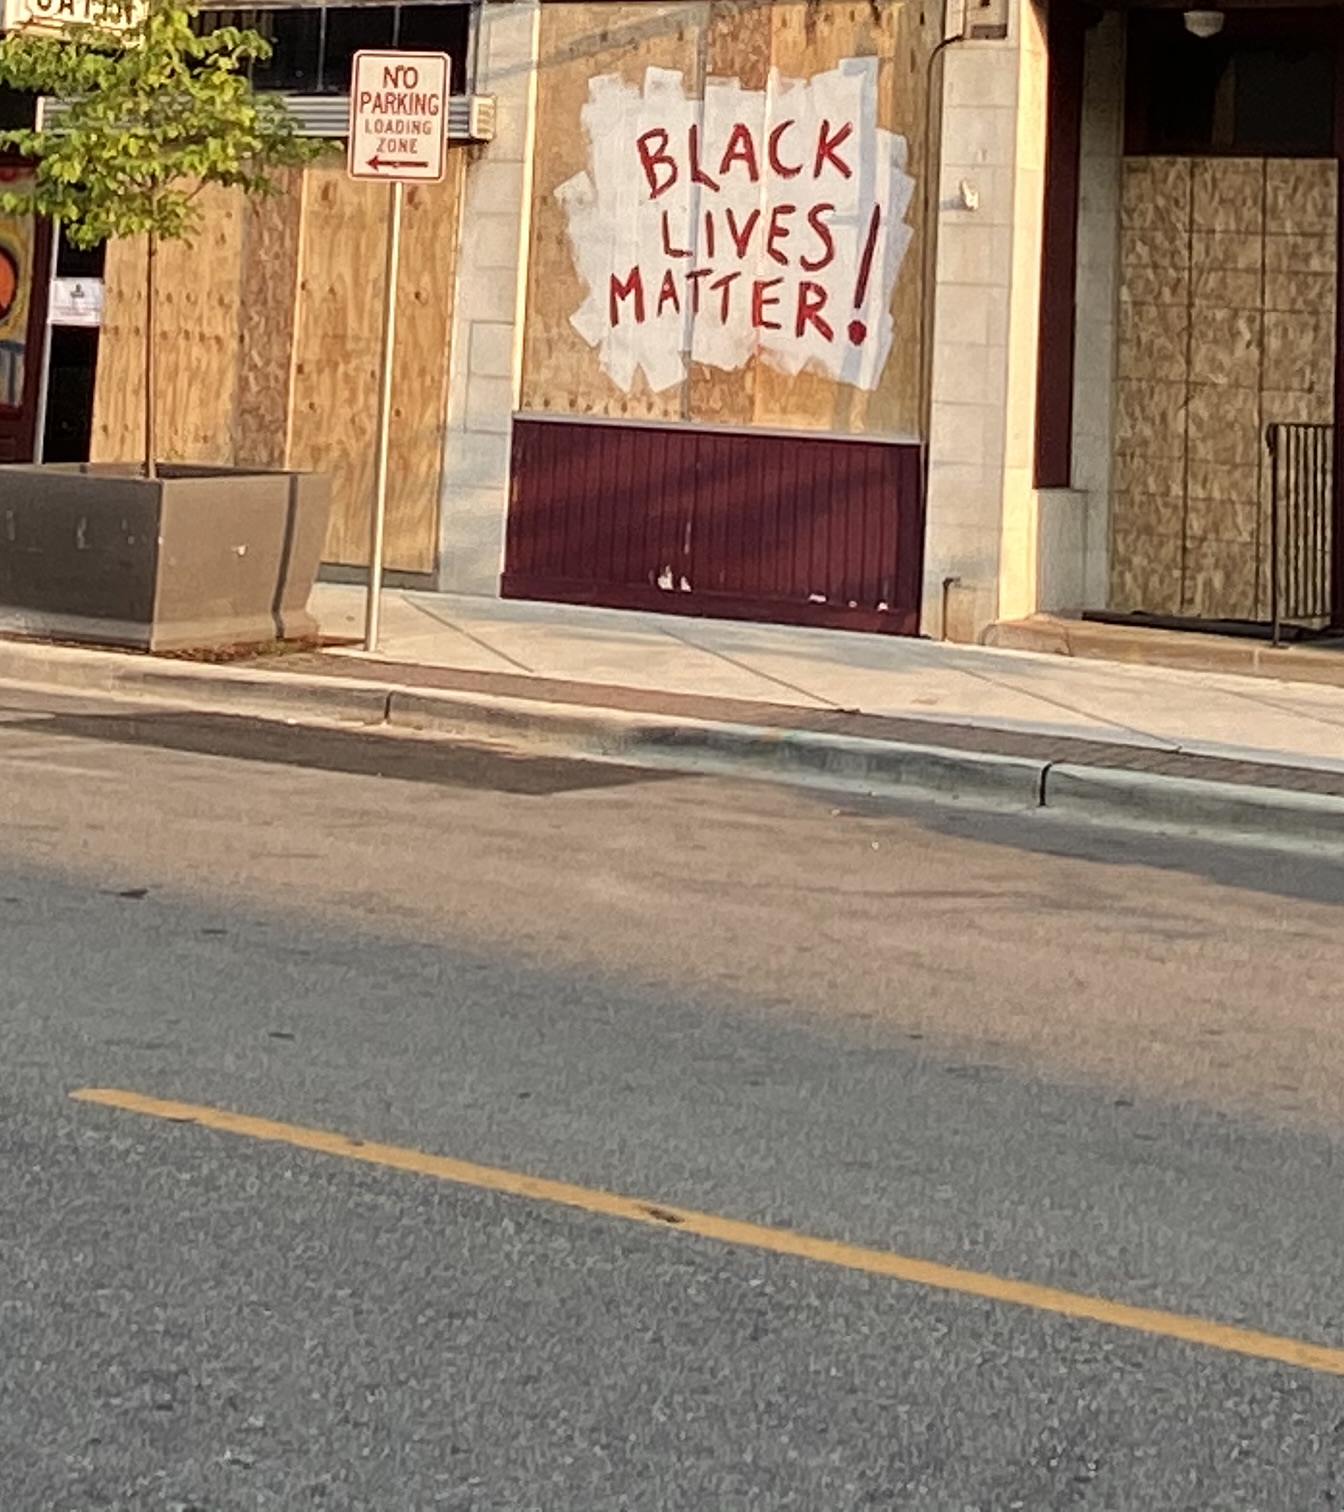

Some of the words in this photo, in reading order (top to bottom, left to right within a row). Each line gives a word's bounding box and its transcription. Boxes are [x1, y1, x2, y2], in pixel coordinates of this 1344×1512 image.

[383, 64, 418, 89] NO
[360, 91, 439, 116] PARKING
[364, 119, 432, 135] LOADING
[376, 138, 417, 154] ZONE
[637, 119, 853, 200] BLACK
[662, 203, 836, 272] LIVES
